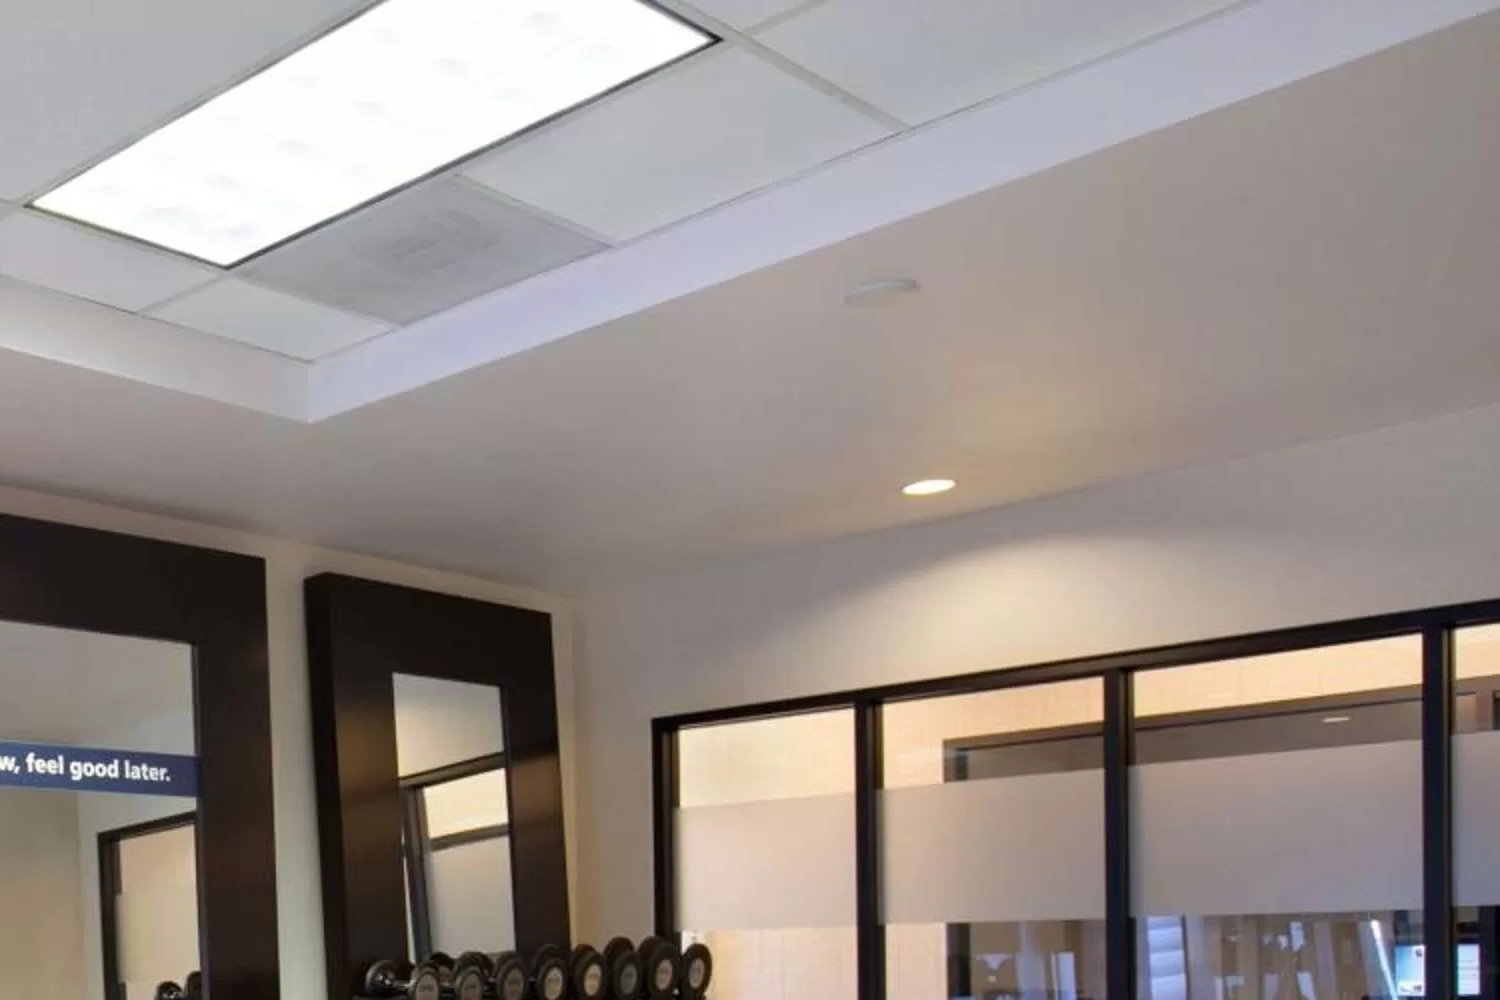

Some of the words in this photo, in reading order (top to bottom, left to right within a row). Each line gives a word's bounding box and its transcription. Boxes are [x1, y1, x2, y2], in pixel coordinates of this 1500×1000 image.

[25, 752, 64, 775] feel
[69, 759, 120, 781] good
[124, 759, 171, 783] later.
